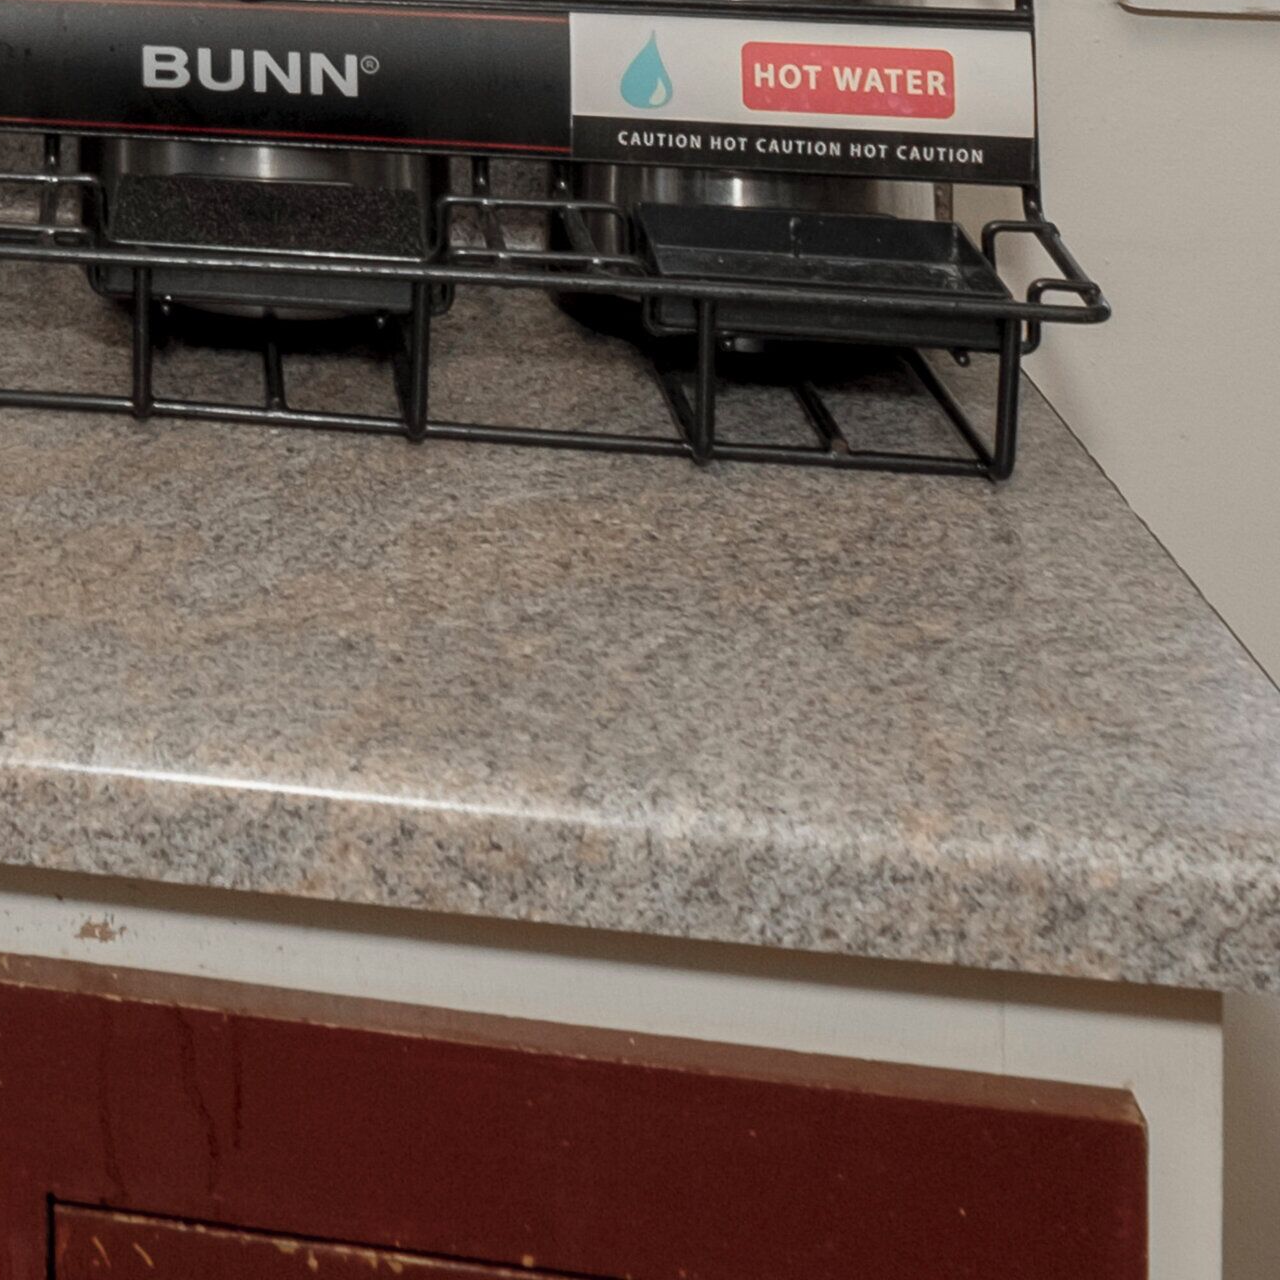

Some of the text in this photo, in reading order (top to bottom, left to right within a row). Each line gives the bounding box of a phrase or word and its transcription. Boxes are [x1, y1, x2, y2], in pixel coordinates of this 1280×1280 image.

[754, 62, 947, 96] HOT WATER
[617, 130, 984, 164] CAUTION HOT CAUTION HOT CAUTION
